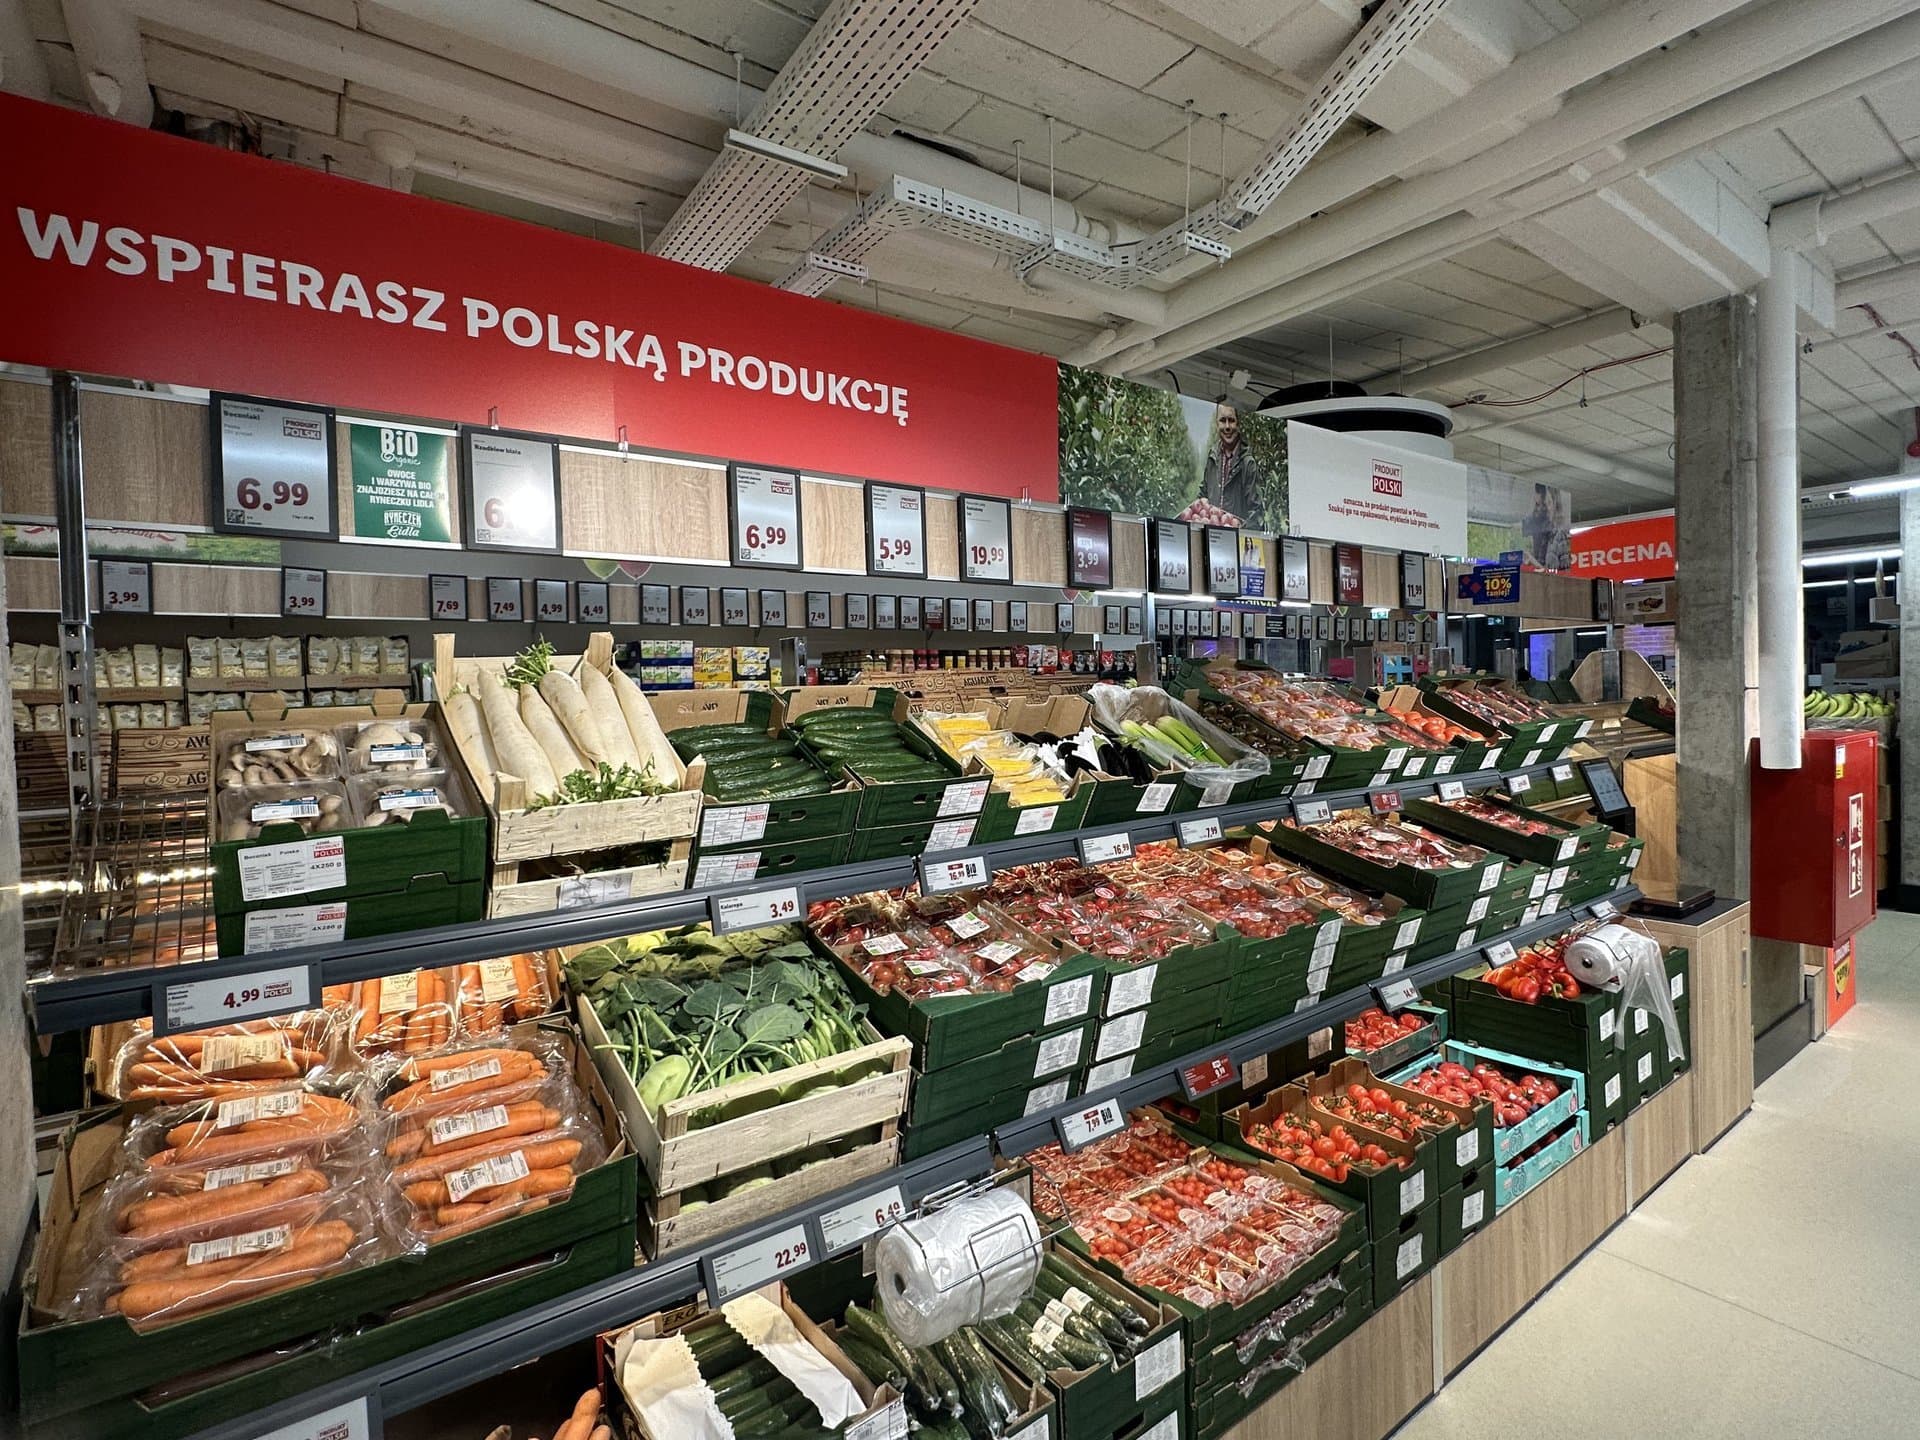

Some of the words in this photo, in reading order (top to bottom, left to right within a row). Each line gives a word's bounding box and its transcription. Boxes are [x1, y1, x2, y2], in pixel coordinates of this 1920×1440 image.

[17, 207, 447, 331] WSPIERASZ
[463, 297, 667, 381] POLSKĄ
[678, 340, 909, 426] PRODUKCJĘ
[285, 420, 319, 429] PRODUKT
[284, 428, 321, 439] POLSKI
[387, 469, 416, 480] OWOCE
[1375, 464, 1400, 477] PRODUKT
[371, 476, 375, 485] I
[376, 477, 417, 489] WARZYWA
[418, 481, 432, 490] BIO
[1373, 477, 1402, 495] POLSKI
[237, 478, 309, 511] 6.99
[356, 485, 405, 497] ZNAJDZIESZ
[406, 489, 418, 498] NA
[369, 496, 411, 507] RYNECZKU
[413, 499, 434, 508] LIDLA
[1371, 502, 1389, 511] produkt
[384, 511, 421, 527] RYNECZEK
[1328, 503, 1344, 516] Szukaj
[1418, 520, 1427, 528] przy
[387, 526, 420, 537] Lidla
[746, 525, 786, 549] 6.99
[880, 538, 911, 560] 5.99
[971, 545, 1004, 565] 19.99
[1077, 551, 1098, 568] 3.99
[1162, 561, 1186, 577] 22.99
[1213, 566, 1236, 583] 15.99
[1342, 577, 1358, 591] 11.99
[1484, 578, 1512, 591] 10%
[1407, 584, 1422, 598] 11.99
[108, 591, 139, 605] 3.99
[289, 595, 314, 609] 3.99
[436, 600, 459, 613] 7.69
[493, 602, 515, 614] 7.49
[541, 603, 562, 616] 4.99
[583, 605, 603, 617] 4.49
[686, 608, 705, 619] 4.99
[726, 609, 743, 620] 3.99
[765, 610, 780, 621] 7.49
[811, 611, 825, 621] 7.49
[1205, 827, 1218, 838] 7.99
[314, 848, 344, 858] POLSKI
[1113, 843, 1130, 855] 16.99
[770, 900, 794, 918] 3.49
[223, 988, 260, 1008] 4.99
[264, 987, 291, 998] POLSKI
[1086, 1117, 1100, 1132] 7.99
[775, 1242, 807, 1269] 22.99
